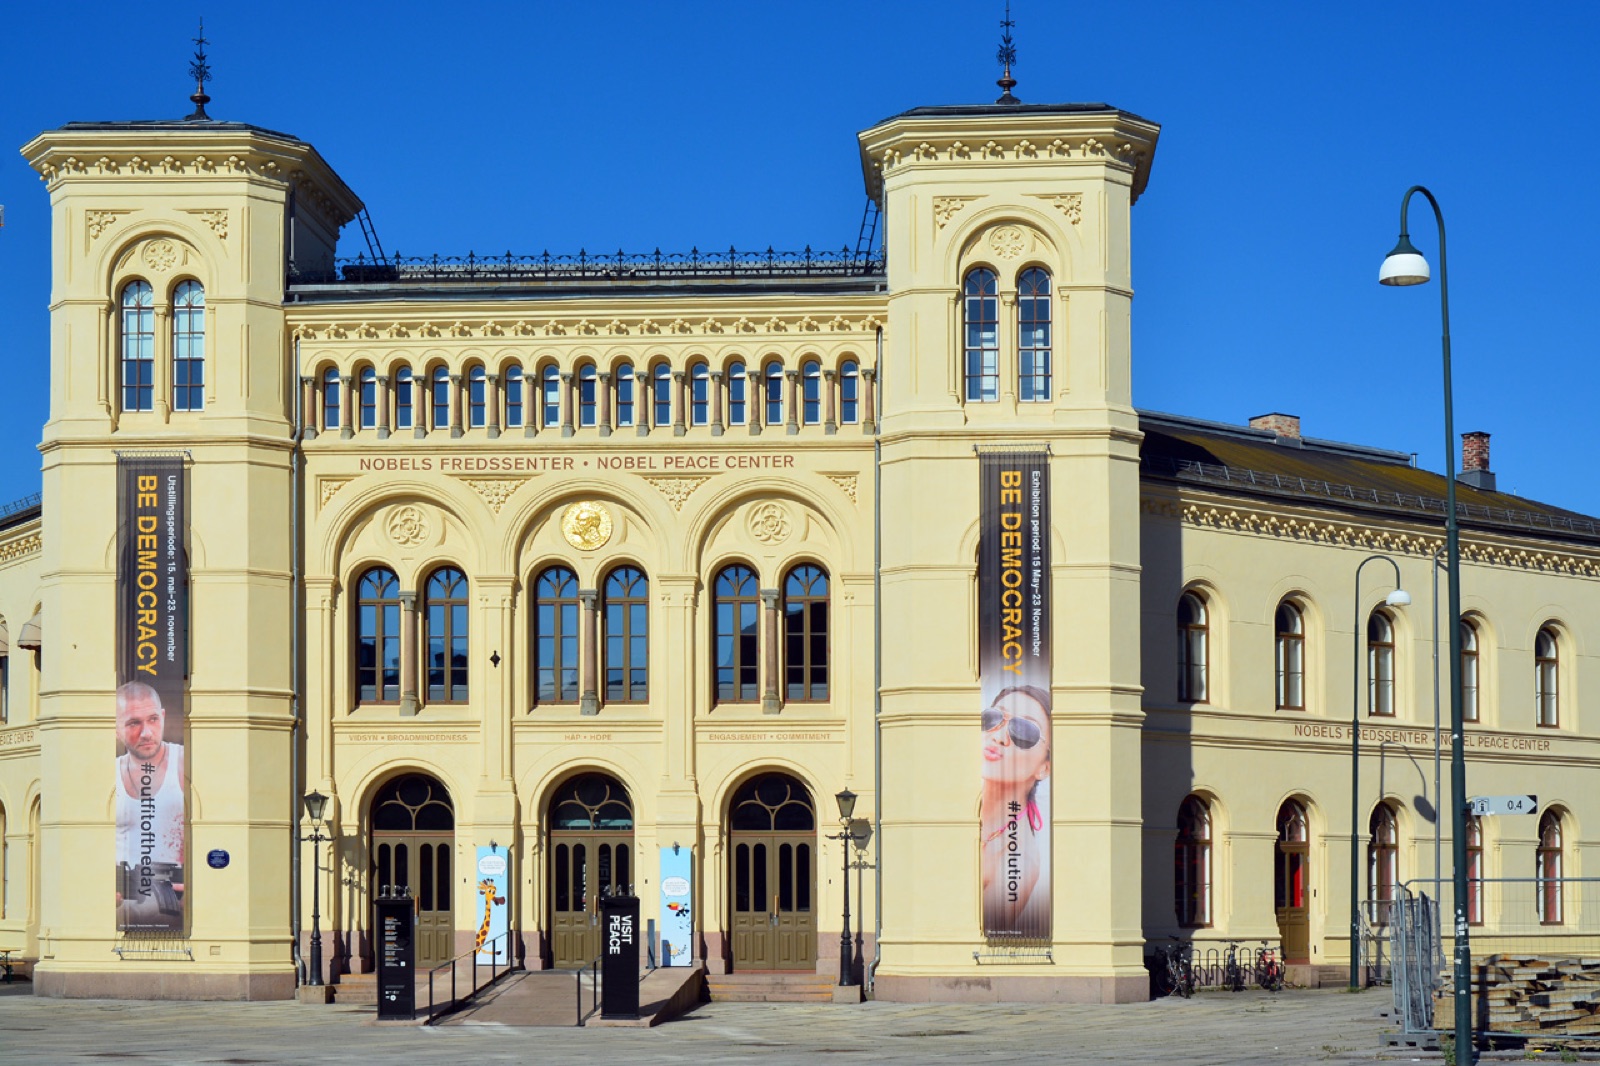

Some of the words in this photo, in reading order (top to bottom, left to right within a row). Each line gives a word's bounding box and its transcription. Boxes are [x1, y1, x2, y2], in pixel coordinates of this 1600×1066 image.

[359, 458, 432, 471] NOBELS
[440, 457, 575, 471] FREDSSENTER
[597, 456, 657, 470] NOBEL
[664, 456, 720, 469] PEACE
[725, 455, 795, 469] CENTER
[137, 475, 158, 508] BE
[1001, 470, 1022, 505] BE
[1032, 470, 1041, 518] Exhibition
[1031, 519, 1041, 554] period:
[167, 561, 176, 575] 15.
[1032, 555, 1041, 567] 15
[136, 516, 158, 676] DEMOCRACY
[1001, 513, 1023, 676] DEMOCRACY
[167, 615, 176, 662] november
[1033, 608, 1042, 657] November
[590, 733, 612, 741] HOPE
[709, 733, 767, 741] ENGASJEMENT
[775, 733, 831, 741] COMMITMENT
[1294, 724, 1342, 739] NOBELS
[1346, 728, 1428, 744] FREDSSENTER
[1478, 736, 1510, 750] PEACE
[1511, 738, 1551, 752] CENTER
[138, 762, 155, 898] #outfitoftheday
[1008, 800, 1022, 902] #revolution
[609, 915, 621, 955] PEACE
[621, 915, 632, 945] VISIT
